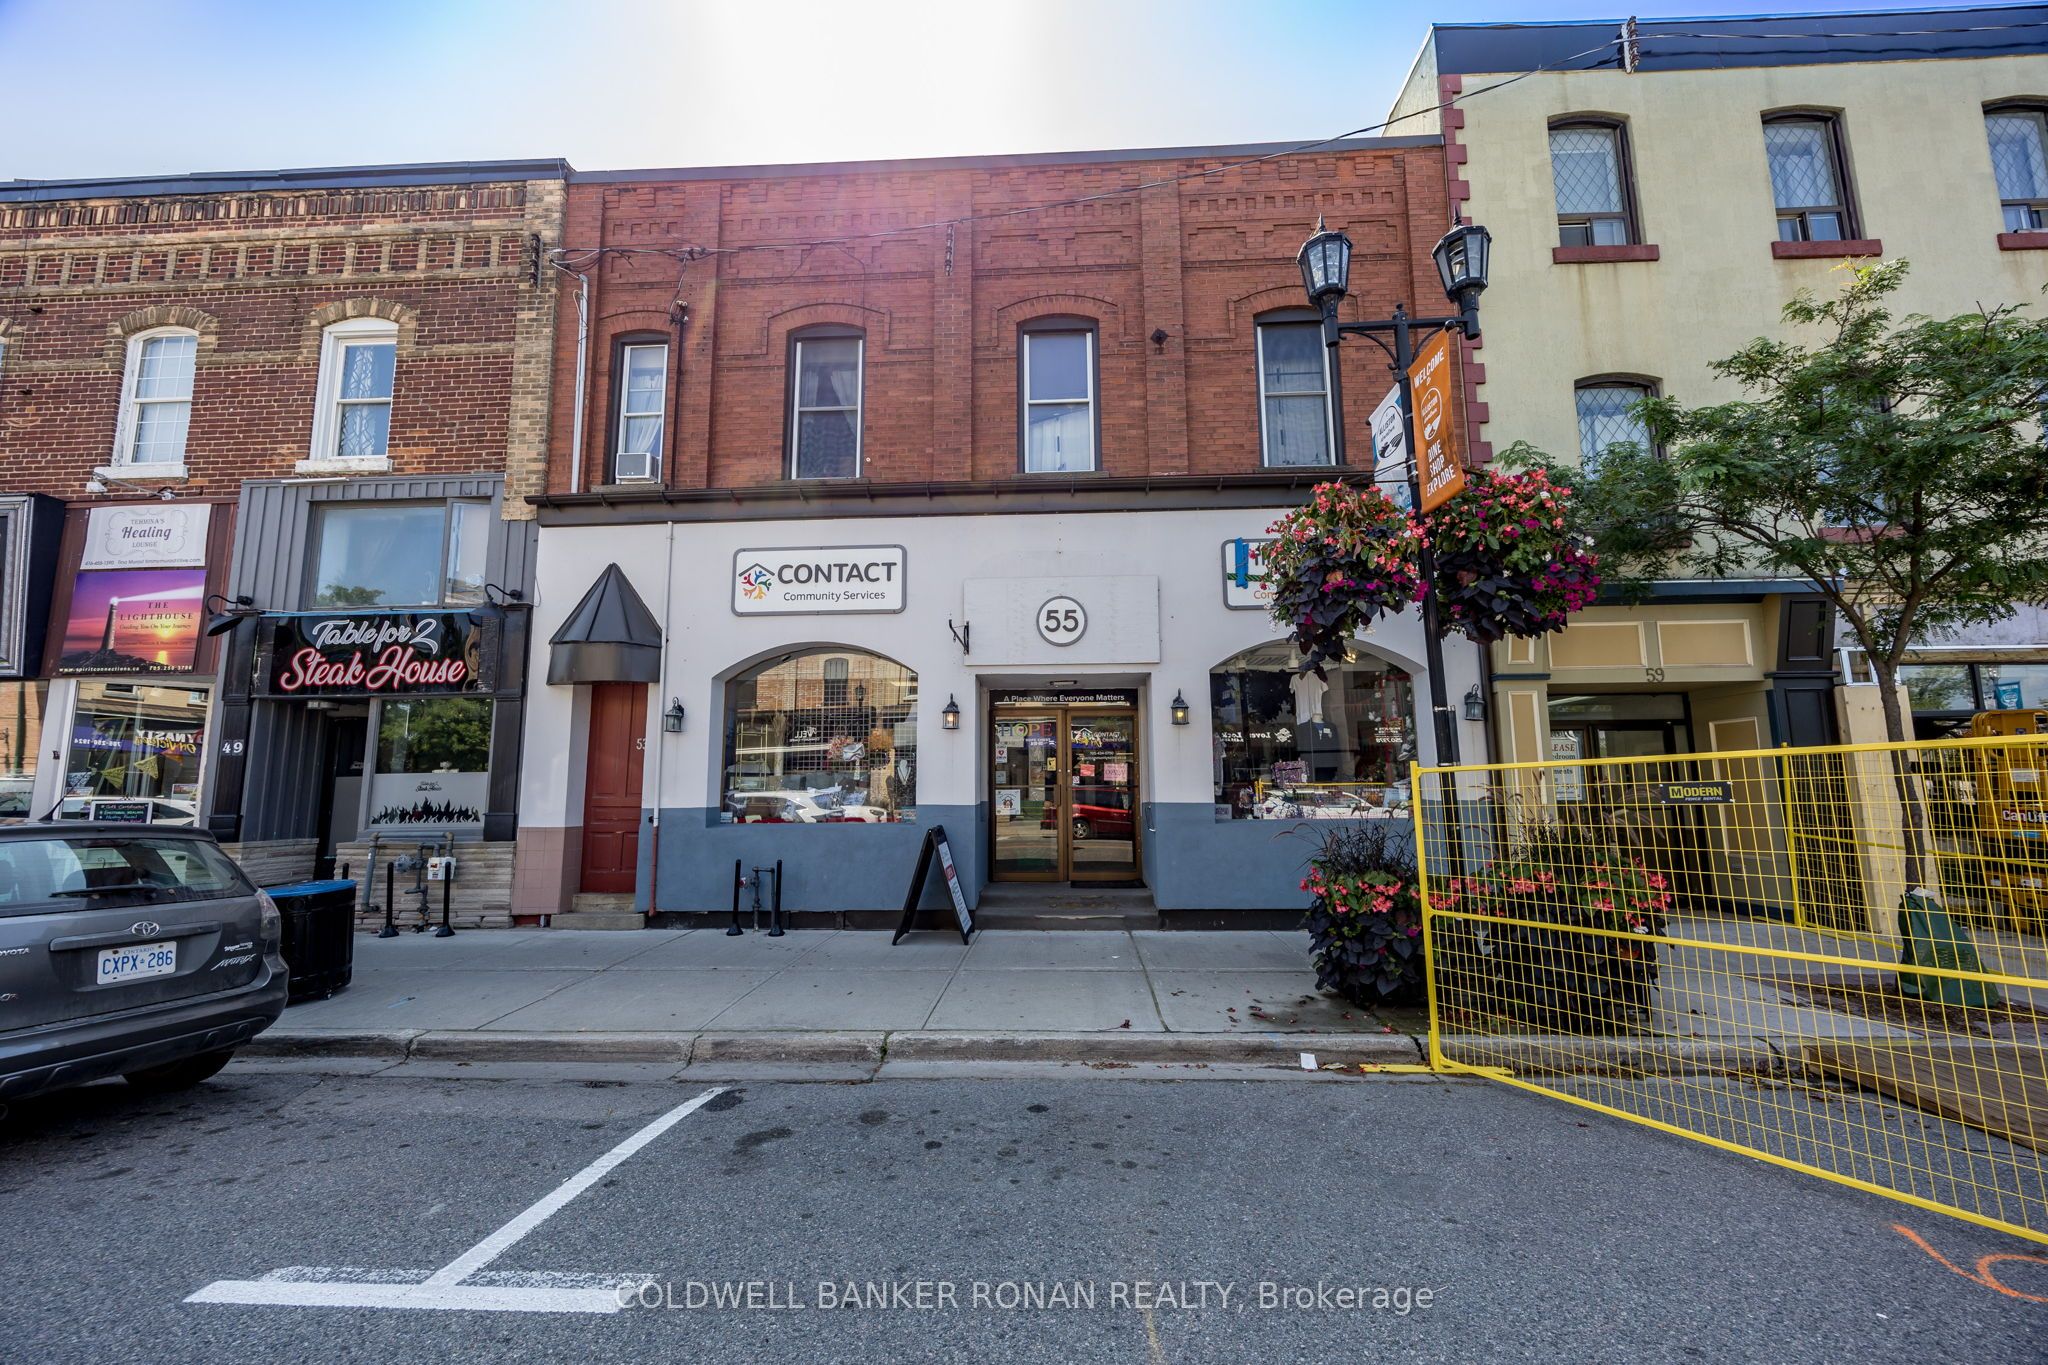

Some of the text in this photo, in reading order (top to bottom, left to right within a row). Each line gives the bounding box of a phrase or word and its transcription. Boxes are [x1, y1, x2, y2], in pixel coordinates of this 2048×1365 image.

[1414, 347, 1444, 389] WELCOME
[1379, 413, 1396, 436] ALLISTON
[1427, 439, 1442, 462] DINE
[1429, 456, 1445, 478] SHOP
[1426, 464, 1456, 498] EXPLORE
[121, 526, 172, 541] Healing
[777, 562, 898, 585] CONTACT
[148, 601, 169, 609] THE
[783, 591, 886, 603] Community Services
[120, 612, 194, 621] LIGHTHOUSE
[1044, 609, 1079, 633] 55
[312, 618, 439, 655] Table for 2
[280, 645, 467, 691] Steak House
[1645, 667, 1665, 683] 59
[1033, 694, 1058, 702] Where
[1059, 694, 1095, 703] Everyone
[1000, 722, 1053, 737] HOPE
[222, 741, 244, 754] 49
[1552, 743, 1576, 752] EASE
[1669, 785, 1723, 799] MODERN
[123, 947, 155, 956] ONTARIO
[102, 950, 174, 975] CXPX 286
